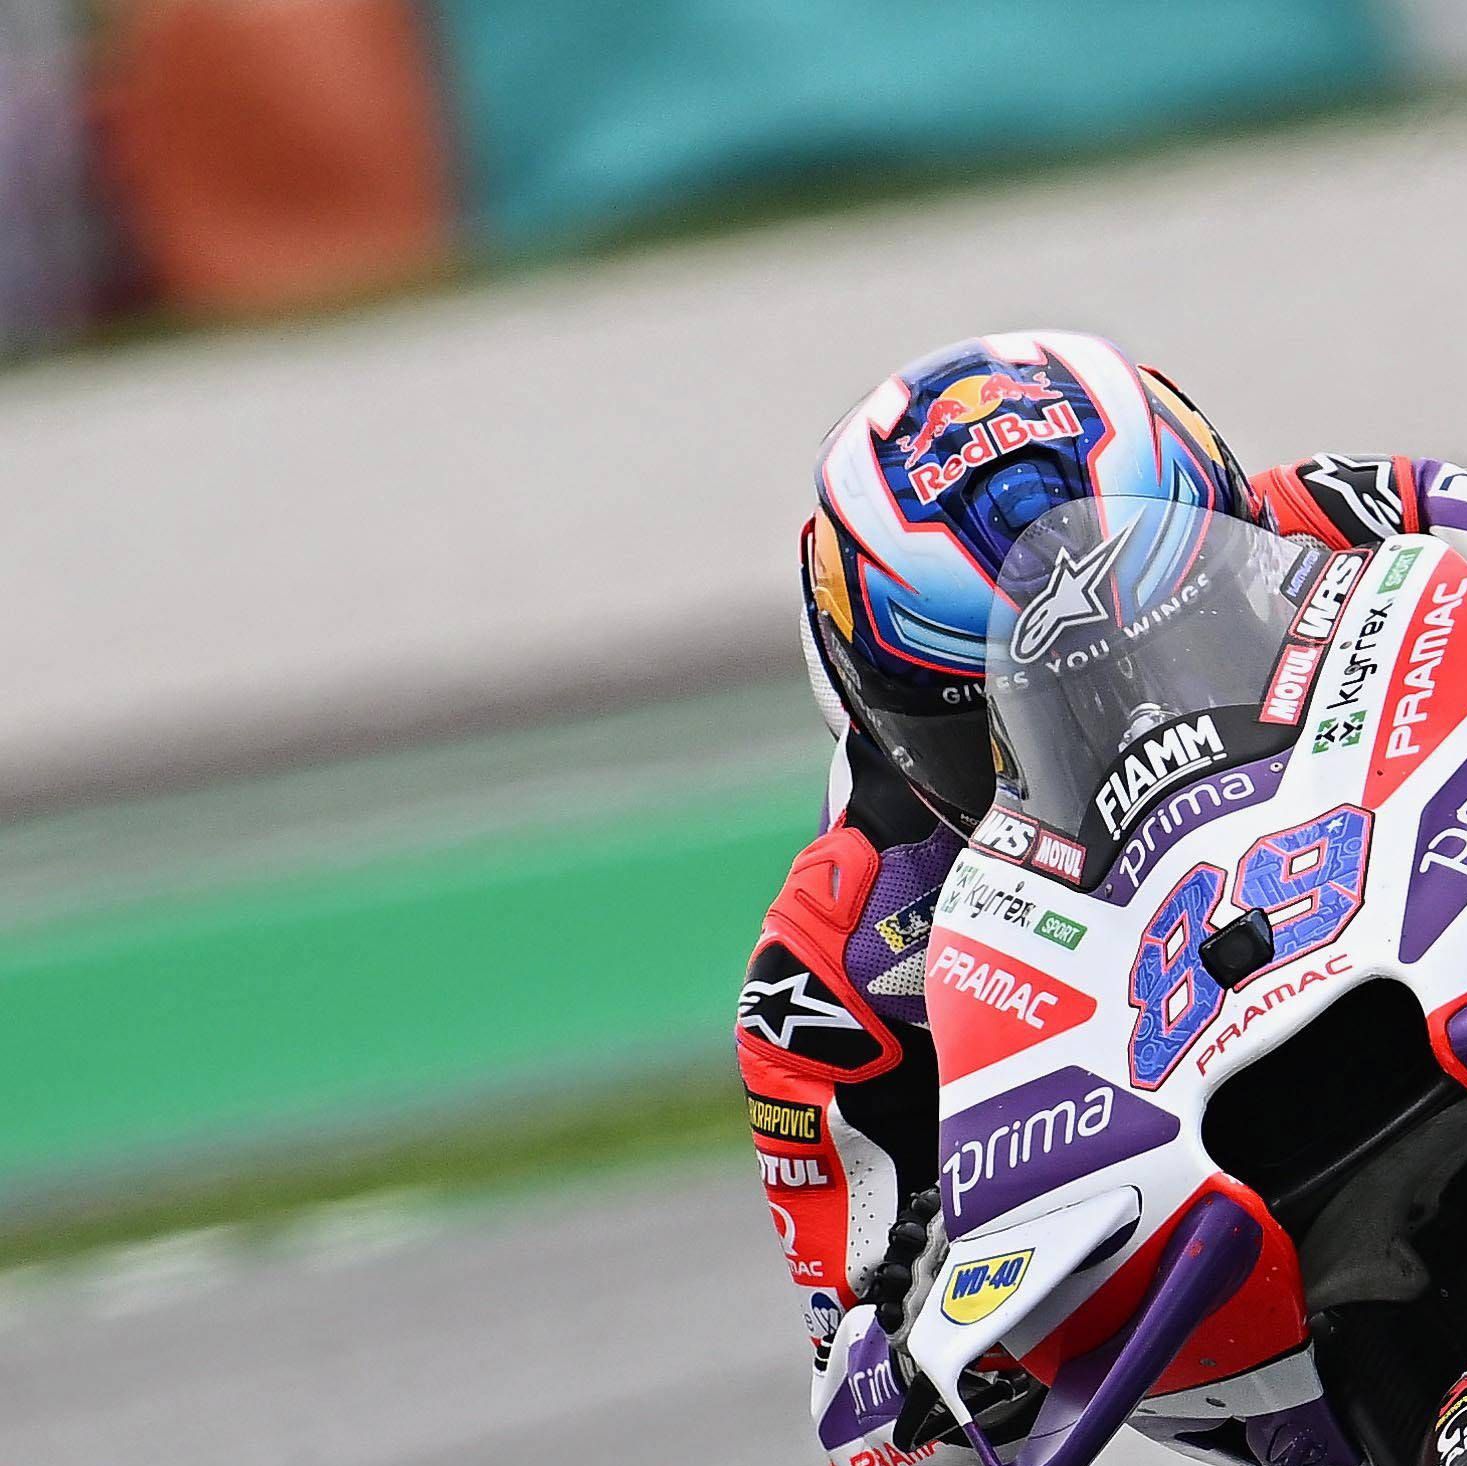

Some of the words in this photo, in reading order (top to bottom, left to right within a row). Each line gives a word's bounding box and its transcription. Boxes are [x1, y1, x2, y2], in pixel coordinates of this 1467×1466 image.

[909, 424, 997, 504] Red
[988, 400, 1084, 454] Bull
[1296, 554, 1363, 638] WRS
[1383, 550, 1417, 588] SPORT
[1045, 639, 1109, 675] YOU
[1267, 648, 1318, 721] MOTUL
[1095, 715, 1224, 834] FIAMM
[972, 811, 1037, 857] WRS
[1036, 835, 1082, 878] MOTUL
[1120, 772, 1254, 887] prima
[1041, 917, 1081, 944] SPORT
[1128, 803, 1375, 1092] 89
[928, 946, 1059, 1030] PRAMAC
[1196, 954, 1352, 1076] PRAMAC
[943, 1085, 1114, 1217] prima
[952, 1257, 1024, 1300] WD-40
